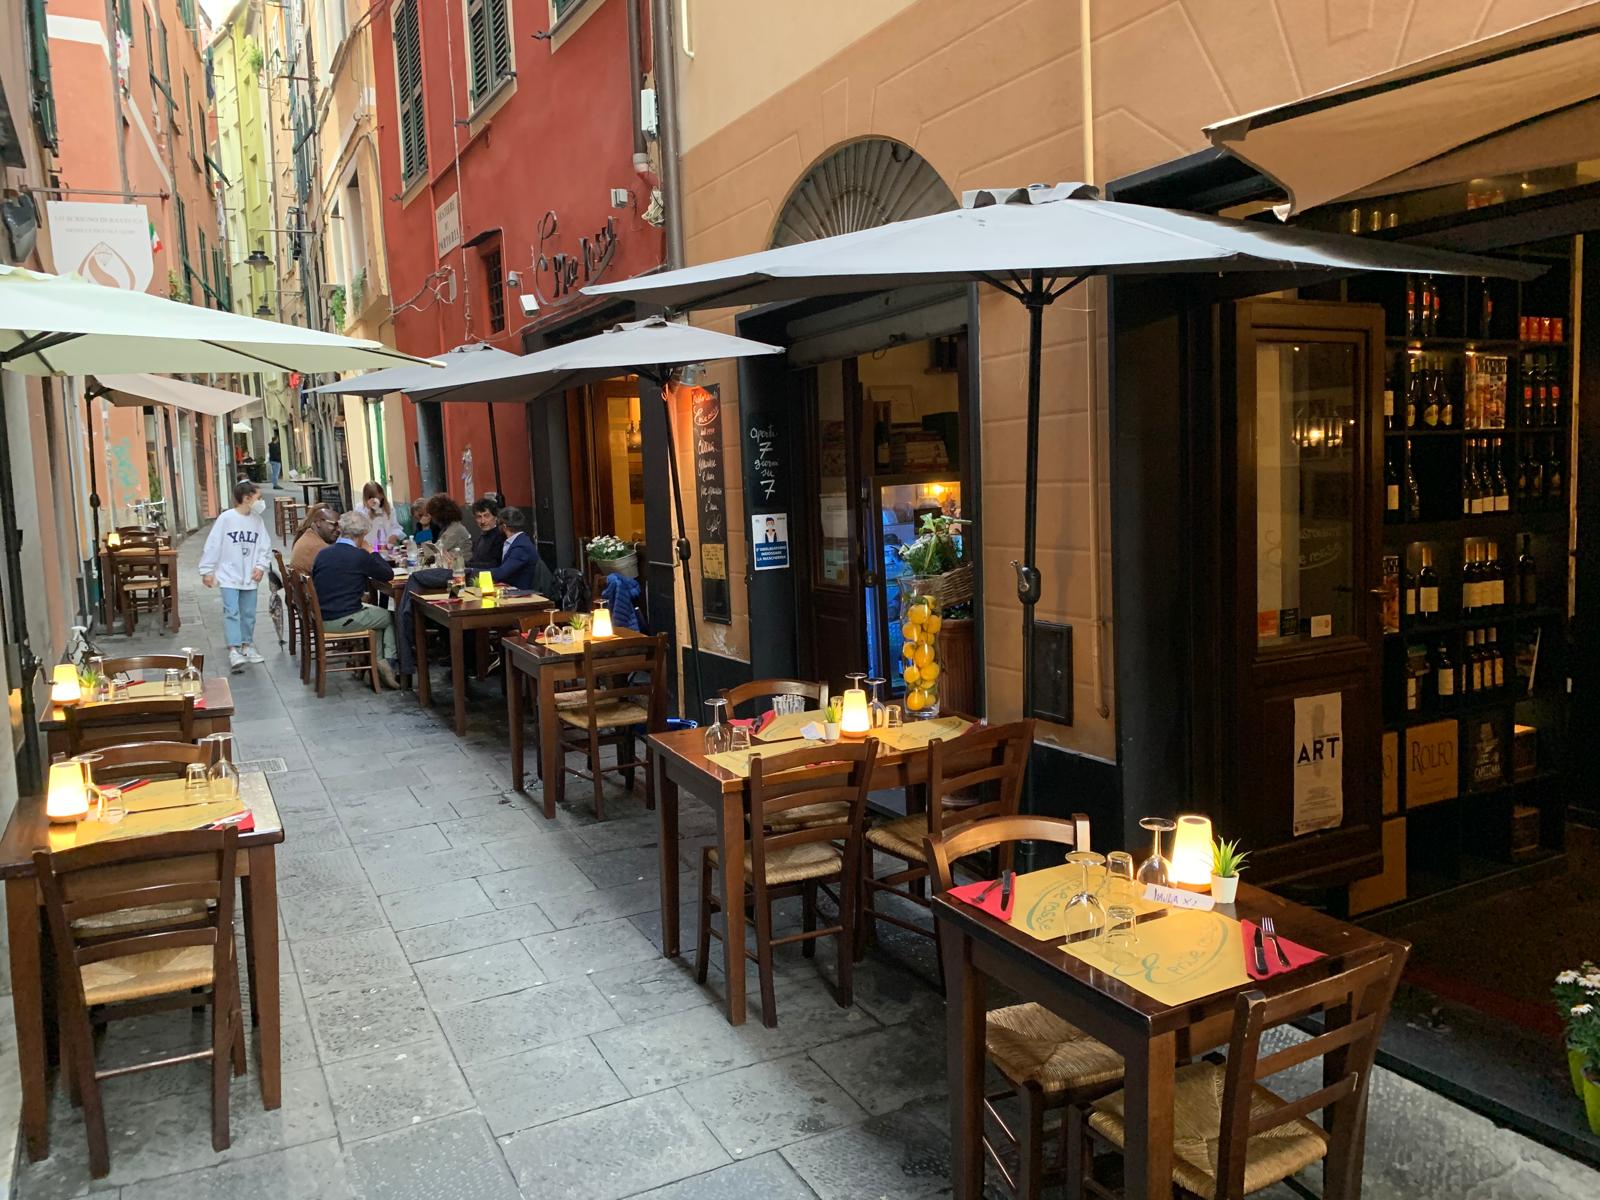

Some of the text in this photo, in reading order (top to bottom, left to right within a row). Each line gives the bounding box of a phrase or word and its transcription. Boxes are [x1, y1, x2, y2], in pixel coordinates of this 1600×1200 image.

[759, 441, 774, 460] 7
[760, 479, 776, 501] 7
[1297, 736, 1340, 763] ART
